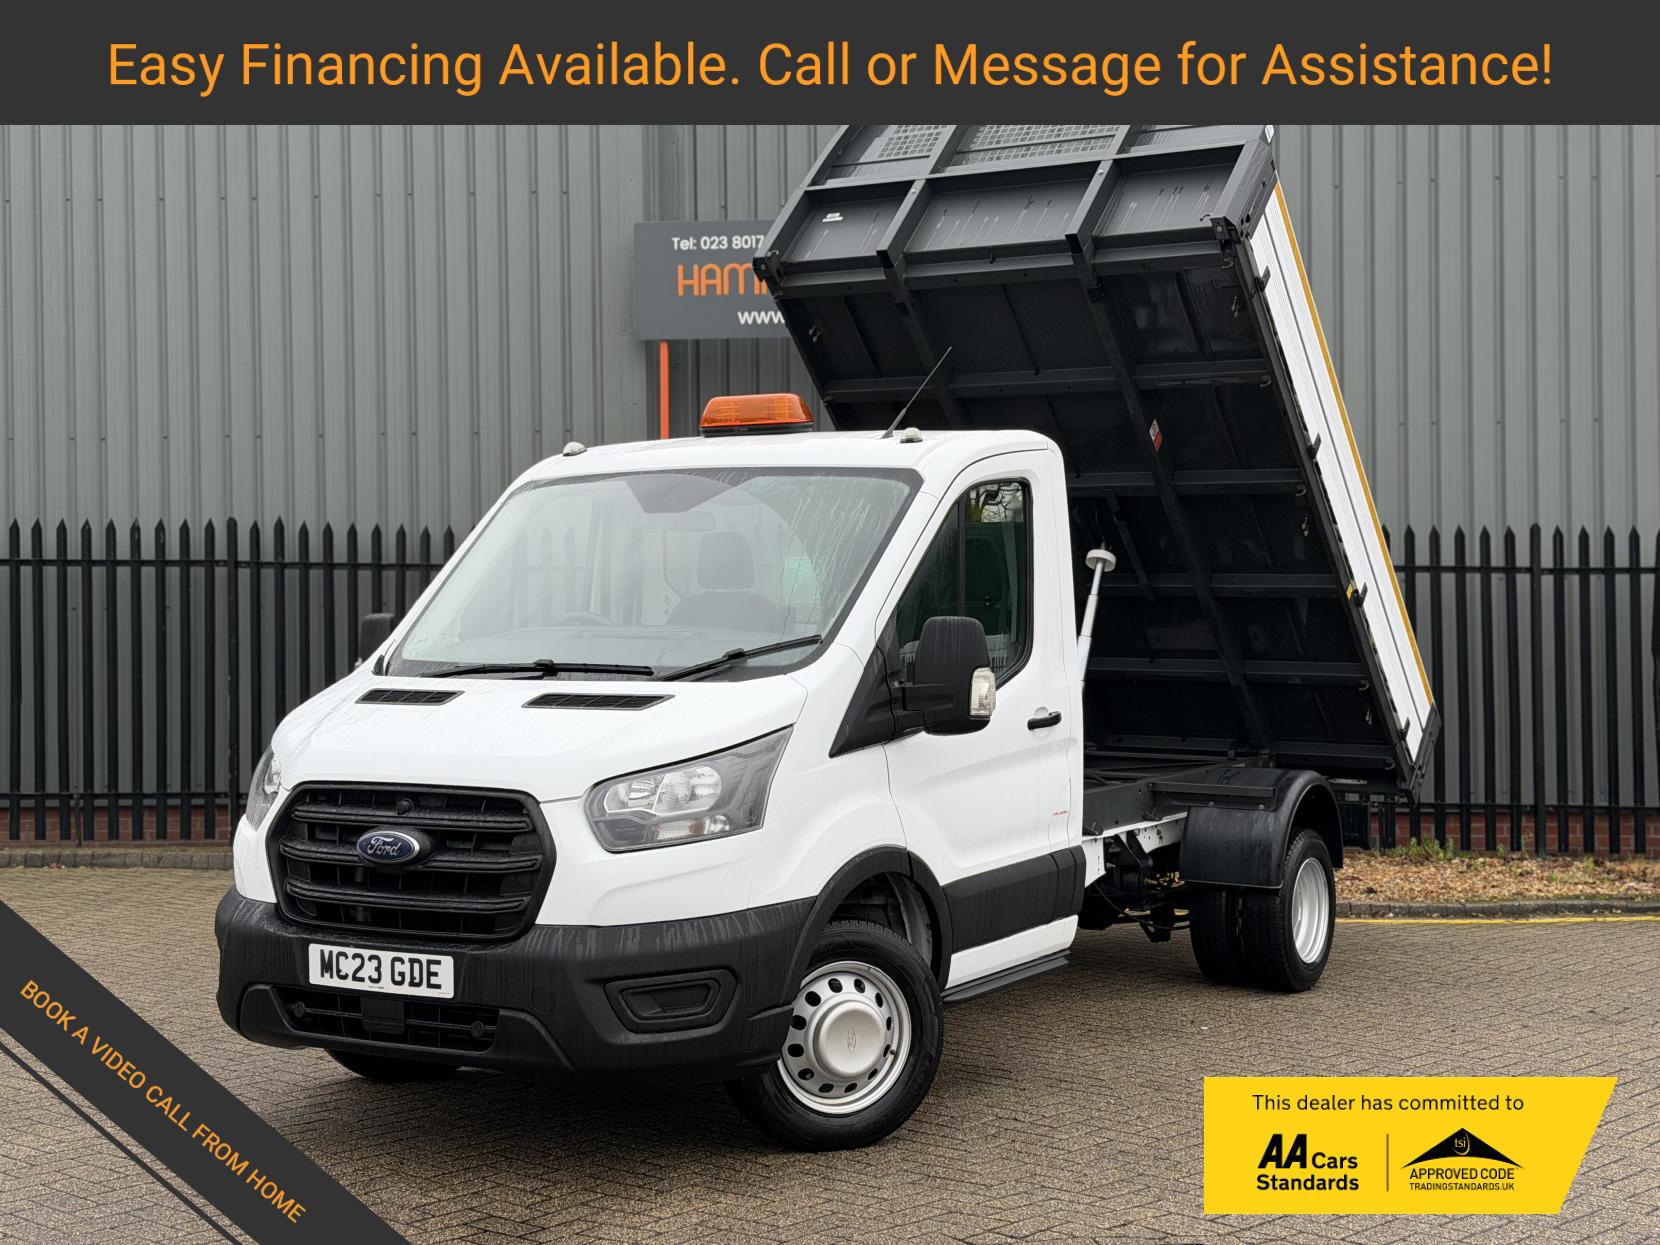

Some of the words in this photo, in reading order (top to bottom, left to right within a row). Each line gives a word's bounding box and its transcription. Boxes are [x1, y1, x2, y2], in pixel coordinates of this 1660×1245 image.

[672, 236, 697, 251] Tel:
[700, 236, 728, 250] 023
[731, 235, 765, 250] 8017
[367, 836, 402, 856] Ford
[319, 948, 382, 985] MC23
[390, 956, 442, 990] GDE
